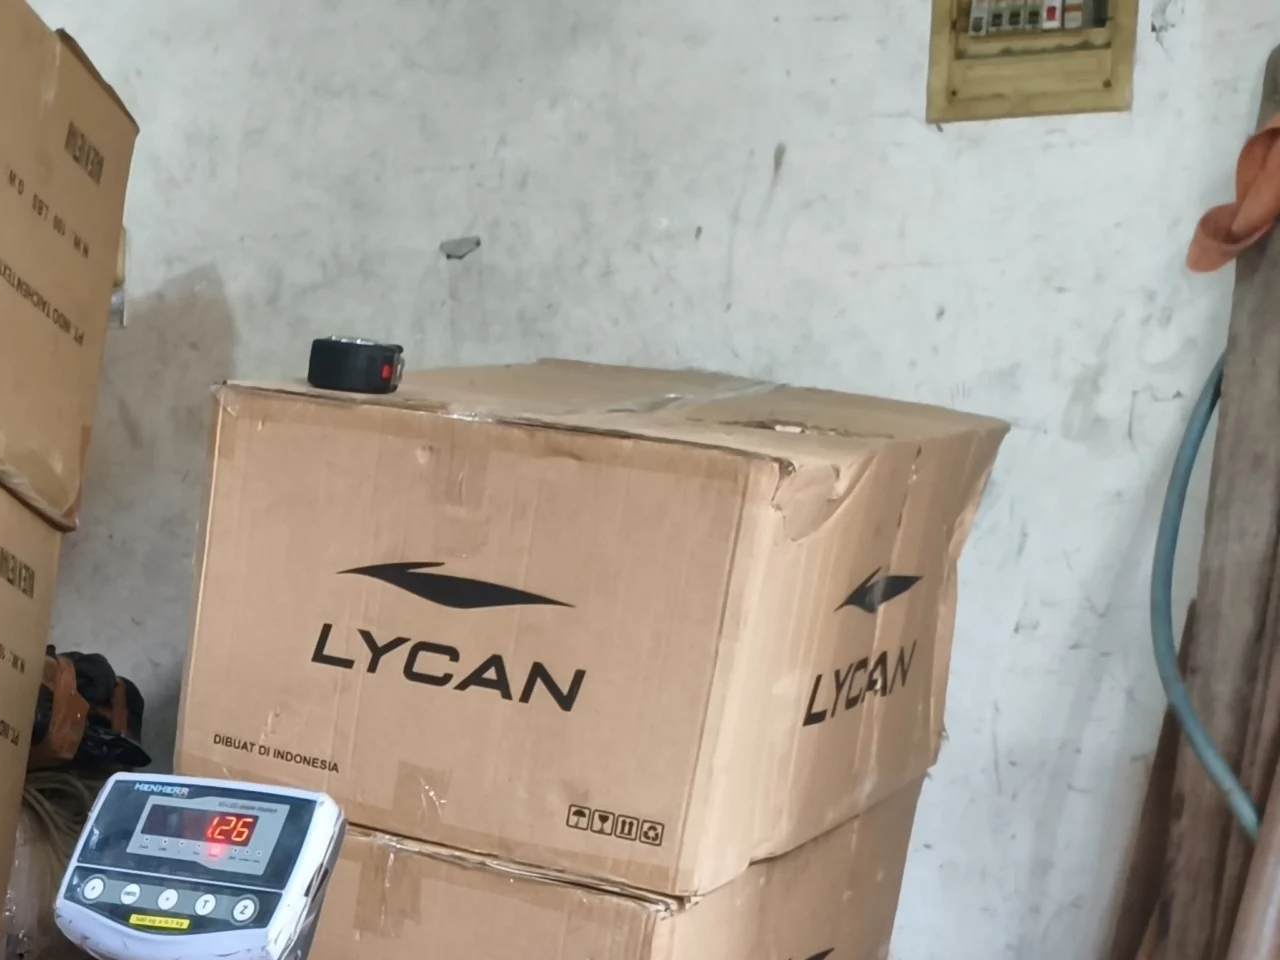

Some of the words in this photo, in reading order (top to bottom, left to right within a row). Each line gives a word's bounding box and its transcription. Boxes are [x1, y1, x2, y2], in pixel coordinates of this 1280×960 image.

[32, 193, 50, 222] LBS
[310, 622, 587, 713] LYCAN
[802, 640, 918, 727] LYCAN
[212, 733, 256, 753] DIBUAT
[258, 744, 272, 758] DI
[273, 748, 341, 774] INDONESIA
[239, 904, 251, 916] Z
